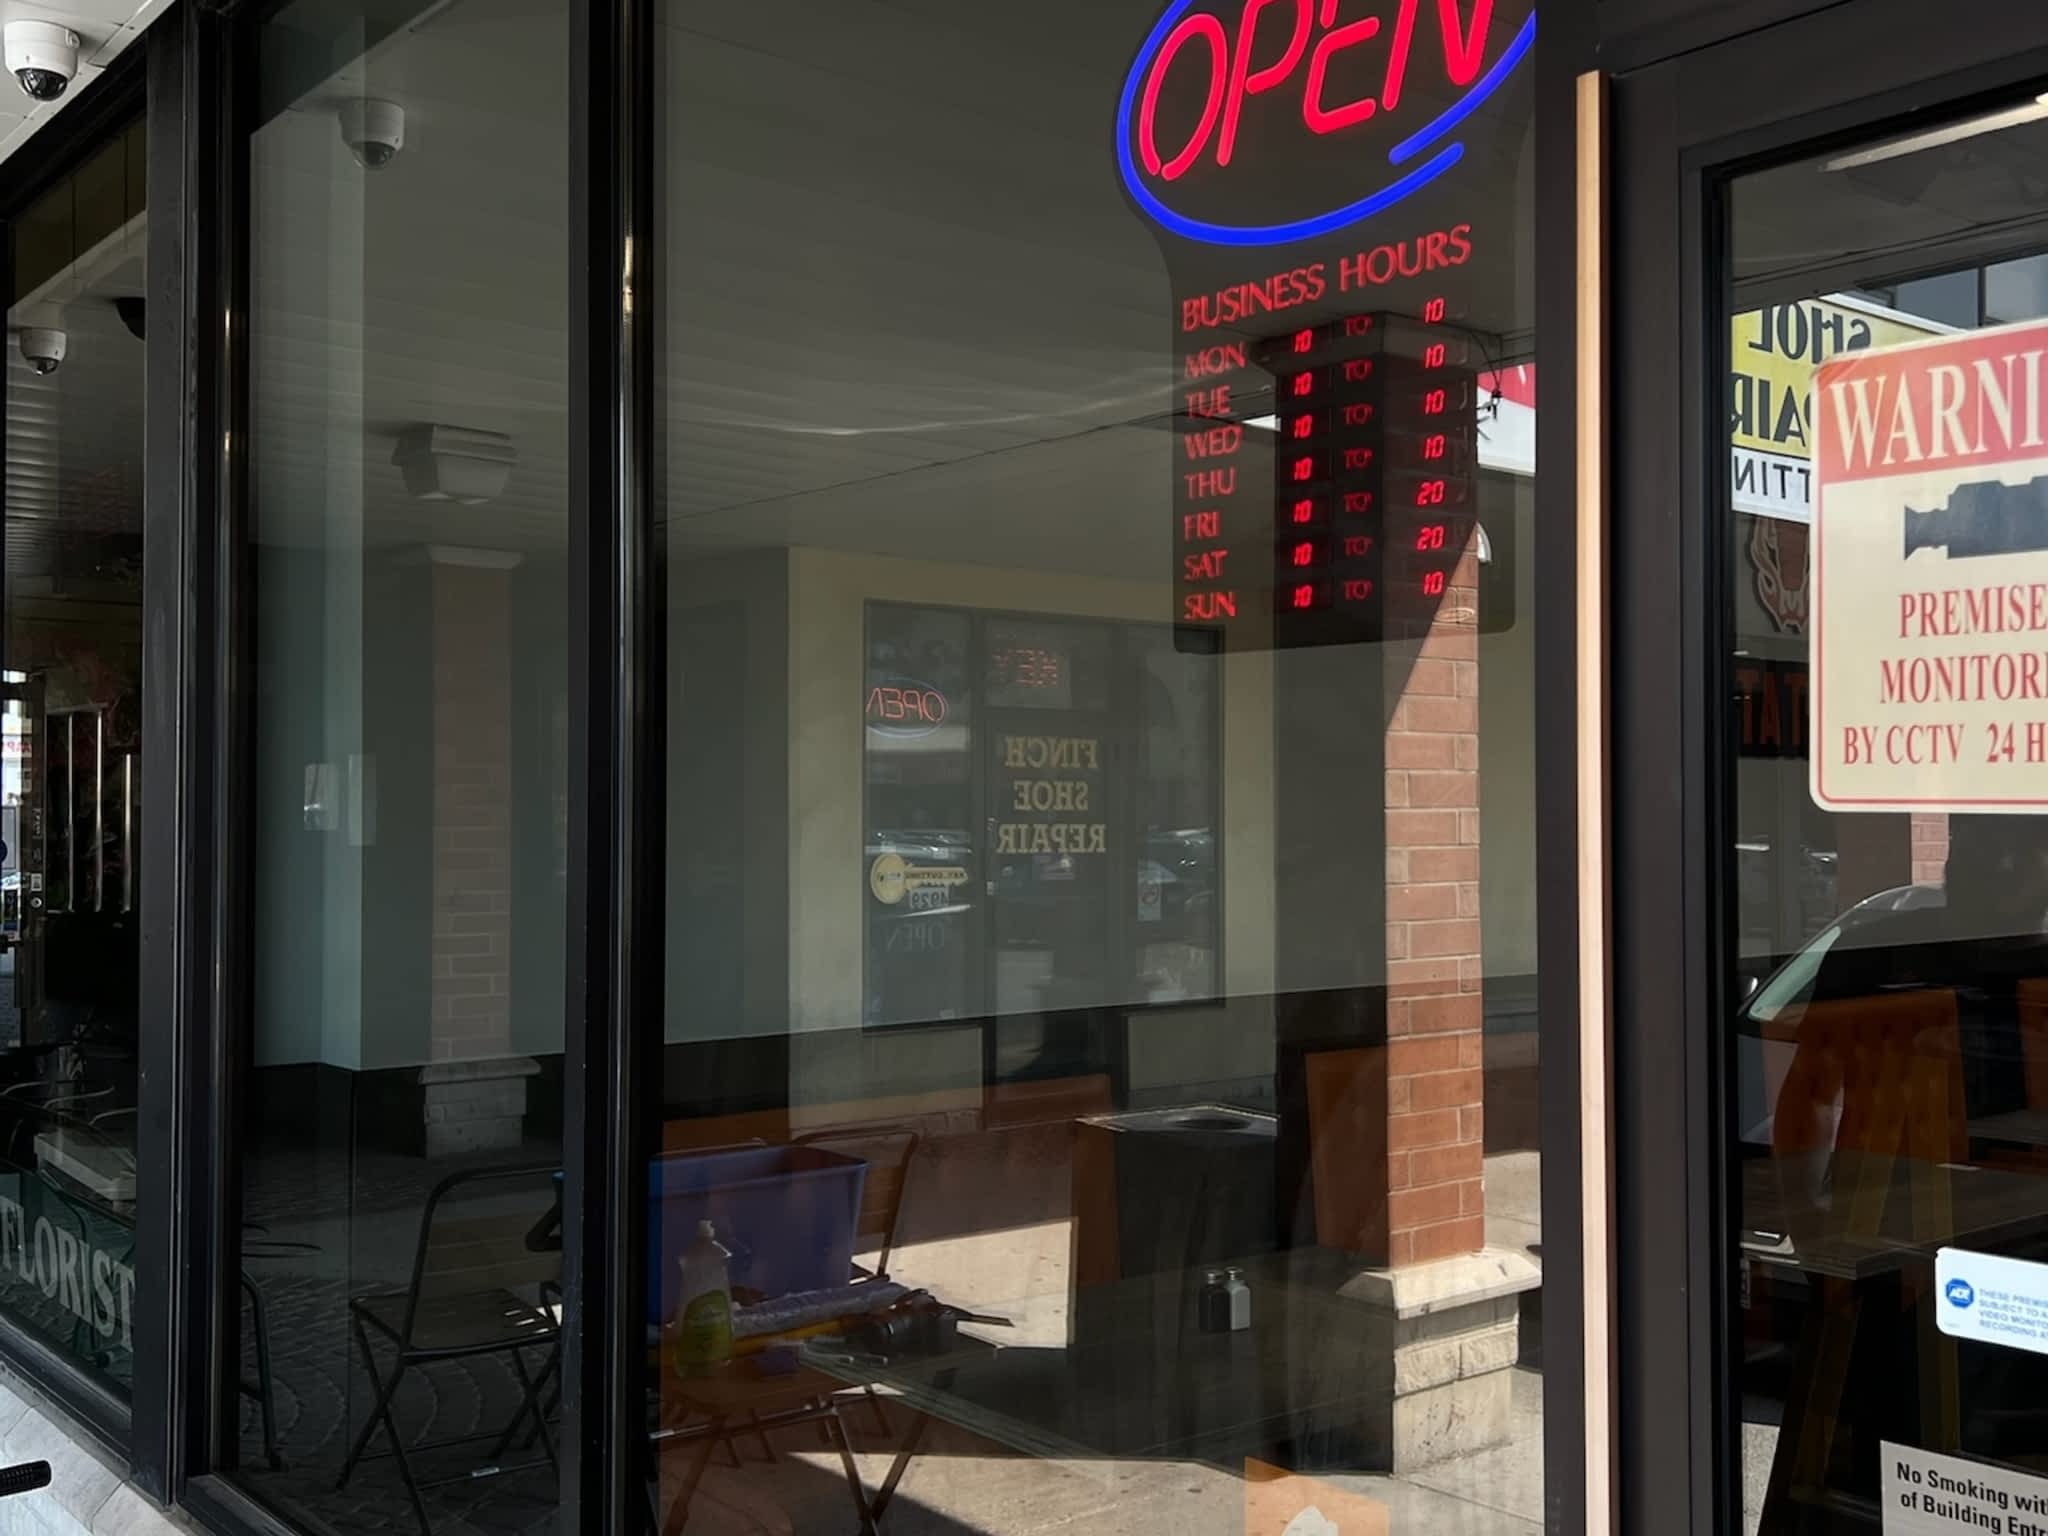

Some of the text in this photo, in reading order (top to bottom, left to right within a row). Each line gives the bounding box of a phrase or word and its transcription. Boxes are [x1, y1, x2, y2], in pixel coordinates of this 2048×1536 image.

[1139, 0, 1494, 180] OPEN
[1183, 224, 1472, 332] BUSINESS HOURS
[1184, 298, 1445, 379] MON 10 TO 10
[1184, 344, 1445, 419] TUE 10 TO 10
[1830, 350, 2045, 472] WARNI
[1184, 389, 1445, 460] WED 10 TO 10
[1184, 434, 1445, 498] THU 10 TO 10
[1184, 480, 1445, 540] FRI 10 TO 20
[1184, 526, 1445, 579] SAT 10 TO 20
[1184, 571, 1445, 620] SUN 10 TO 10
[1899, 584, 2048, 638] PREMISE
[1843, 726, 1878, 764] BY
[1886, 723, 1965, 765] CCTV
[1986, 722, 2015, 763] 24
[0, 1196, 136, 1352] FLORIST
[1897, 1462, 1921, 1484] No
[1928, 1470, 2008, 1510] Smoking
[1901, 1493, 1917, 1509] of
[1923, 1494, 2001, 1535] Building
